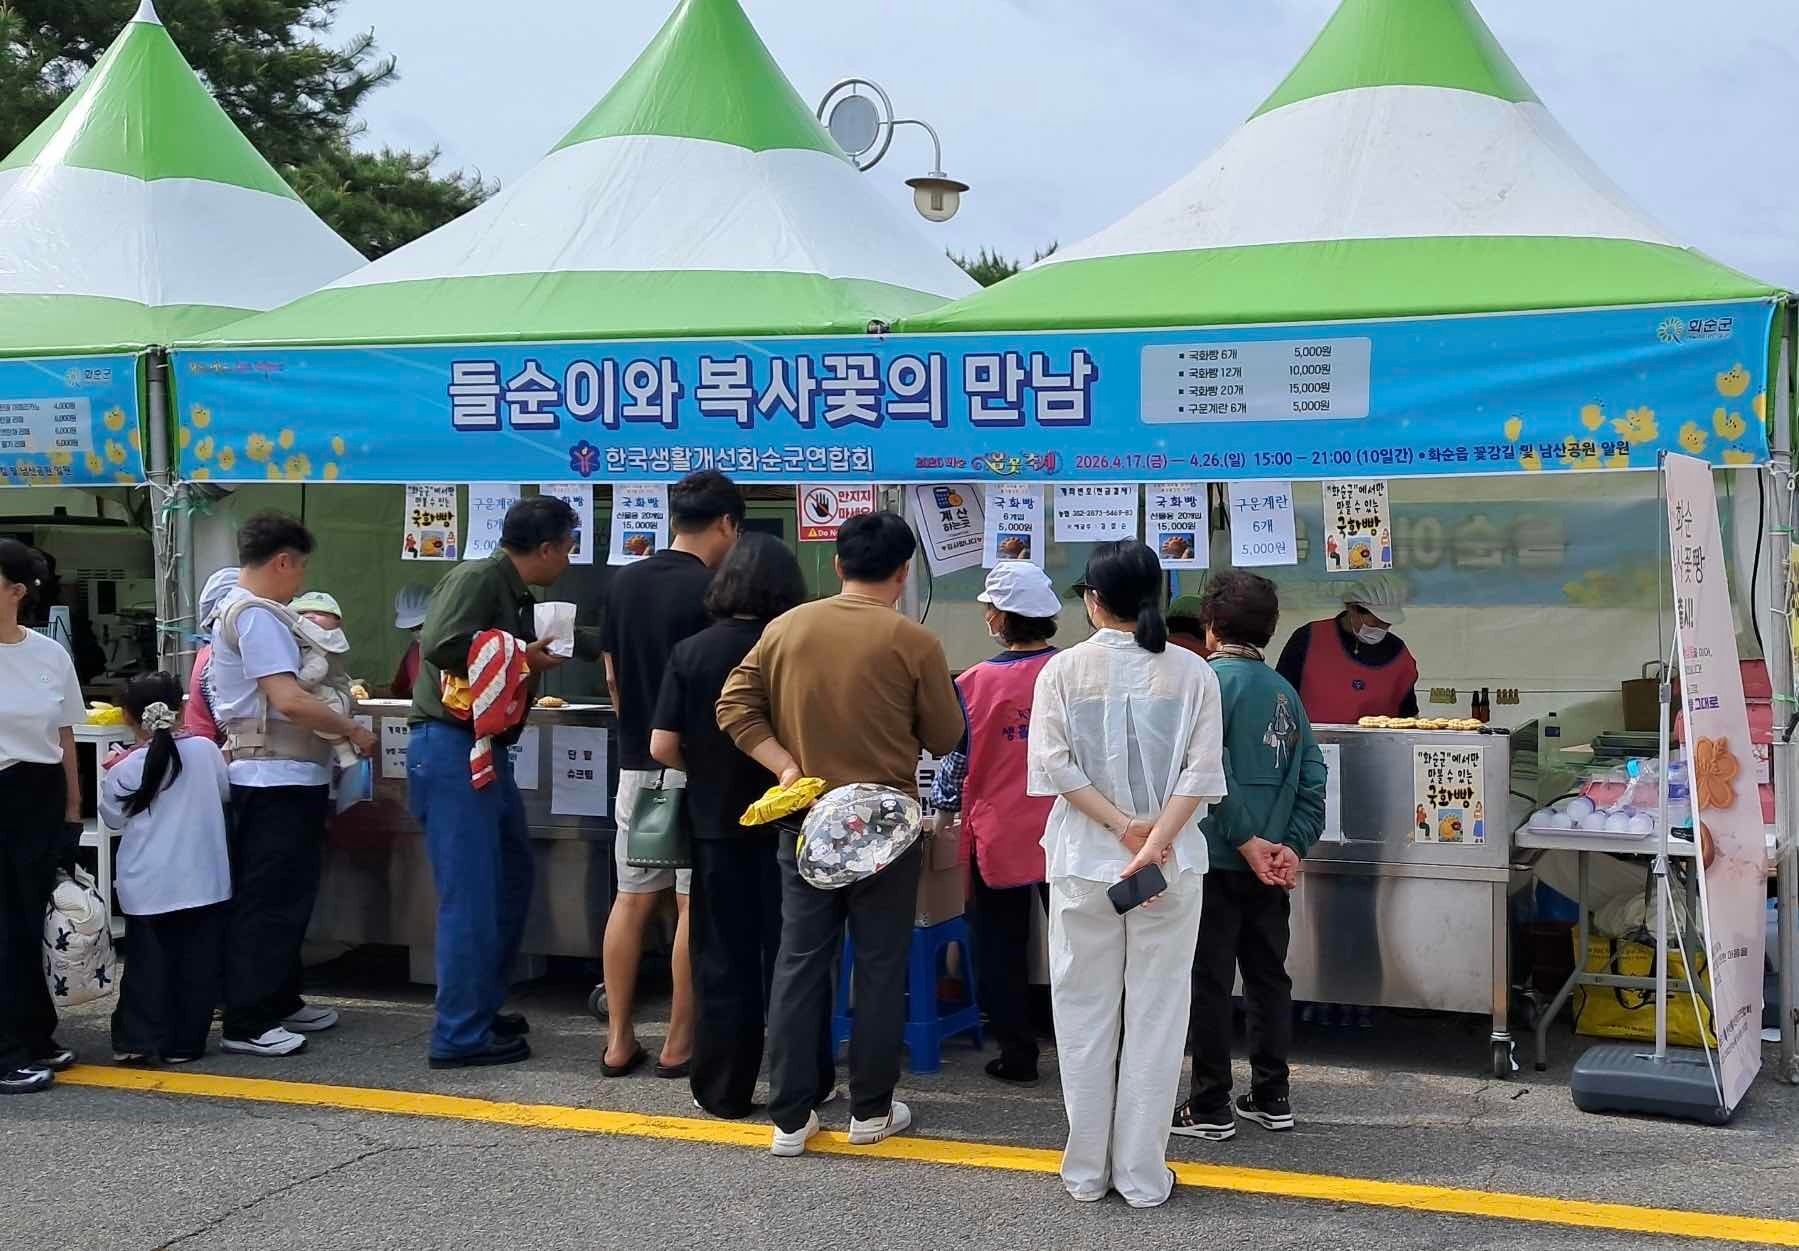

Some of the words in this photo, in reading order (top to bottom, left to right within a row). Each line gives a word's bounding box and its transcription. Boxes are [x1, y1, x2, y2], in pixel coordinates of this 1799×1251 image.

[1189, 350, 1219, 361] 국화빵
[1221, 349, 1238, 360] 6개
[1294, 345, 1332, 358] 5,000원
[1189, 368, 1219, 379] 국화빵
[1221, 367, 1242, 378] 12개
[1289, 364, 1331, 376] 10,000원
[449, 357, 681, 427] 들순이와
[697, 353, 944, 427] 복사꽃의
[964, 350, 1095, 426] 만남
[1189, 385, 1218, 397] 국화빵
[1220, 384, 1244, 396] 20개
[1289, 381, 1330, 394] 15,000원
[1230, 402, 1247, 414] 6개
[1293, 400, 1330, 412] 5,000원
[606, 446, 875, 473] 한국생활개선화순군연합회
[1190, 450, 1246, 468] 4.26.(일)
[1254, 452, 1293, 466] 15:00
[1312, 450, 1352, 465] 21:00
[1356, 447, 1414, 465] (10일간)
[1538, 441, 1597, 458] 남산공원
[993, 496, 1035, 510] 국화빵
[1156, 496, 1198, 508] 국화빵
[1235, 494, 1289, 512] 구운계란
[1355, 500, 1361, 513] 수
[1364, 499, 1379, 514] 있는
[411, 509, 455, 528] 국화빵
[1158, 521, 1196, 531] 15,000원
[1253, 519, 1274, 533] 6개
[999, 523, 1033, 532] 5,000원
[1336, 515, 1381, 539] 국화빵
[1242, 541, 1287, 555] 5,000원
[1428, 769, 1443, 785] 맛볼
[1447, 769, 1453, 783] 수
[1458, 769, 1472, 785] 있는
[1427, 785, 1475, 809] 국화빵
